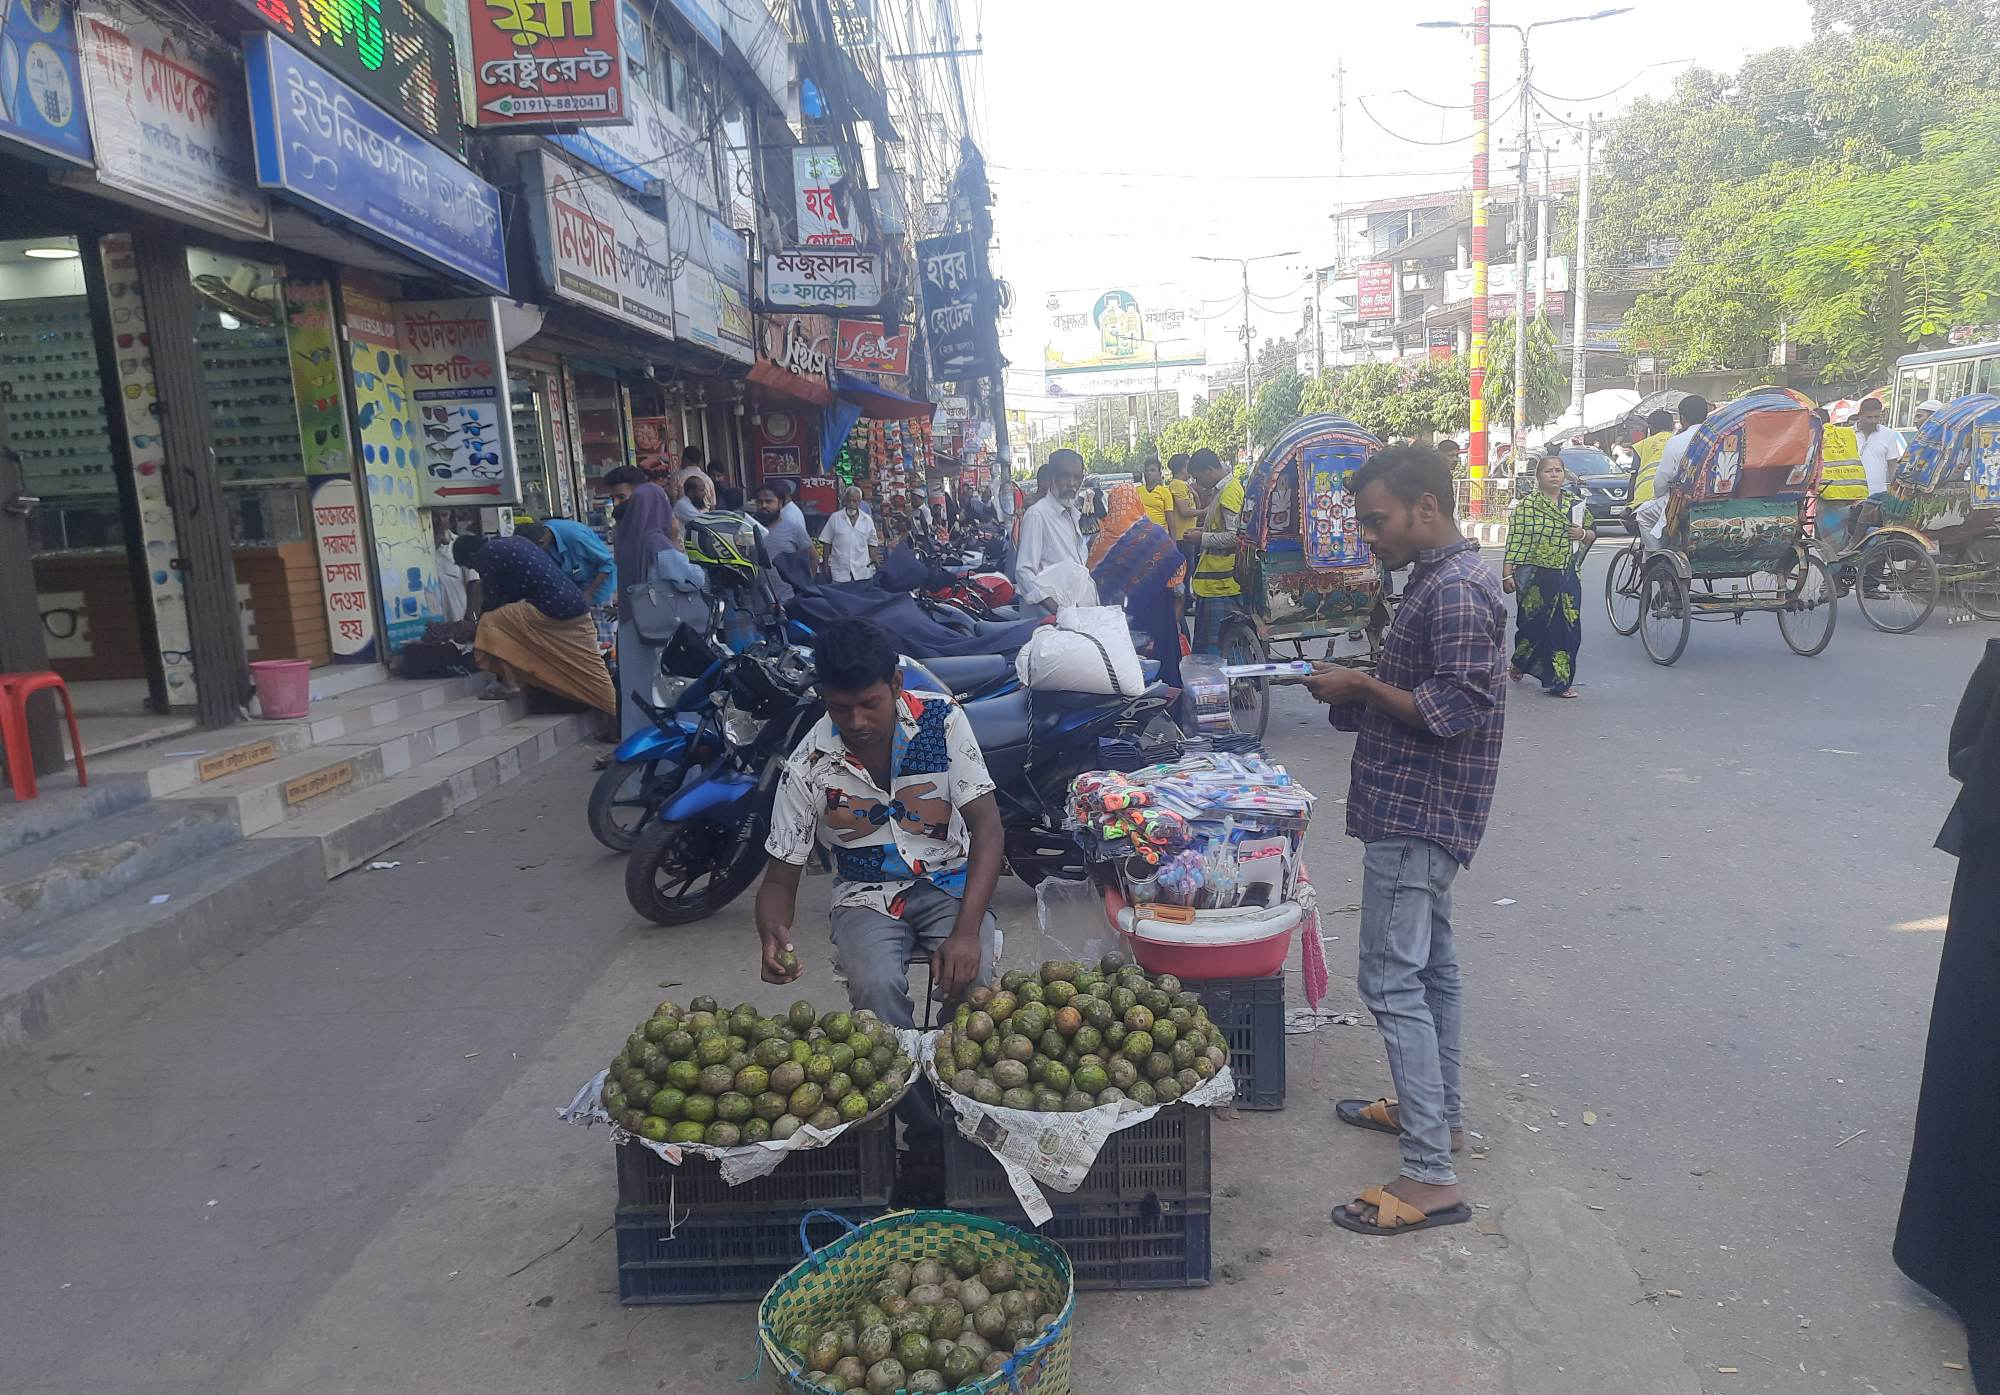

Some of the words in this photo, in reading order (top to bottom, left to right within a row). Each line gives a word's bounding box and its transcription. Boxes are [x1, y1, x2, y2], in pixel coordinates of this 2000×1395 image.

[513, 97, 601, 111] 01919-882041
[288, 67, 430, 198] ইউনিভার্সাল
[552, 175, 618, 284] মিজান
[776, 254, 874, 280] মজুমদার
[793, 278, 856, 301] ফার্মেসী
[403, 306, 489, 350] ইউনিভার্সাল
[410, 355, 493, 383] অপটিক
[315, 506, 357, 526] ডাক্তারের
[325, 562, 362, 583] চশমা
[329, 591, 367, 612] দেওয়া
[339, 619, 363, 640] হয়
